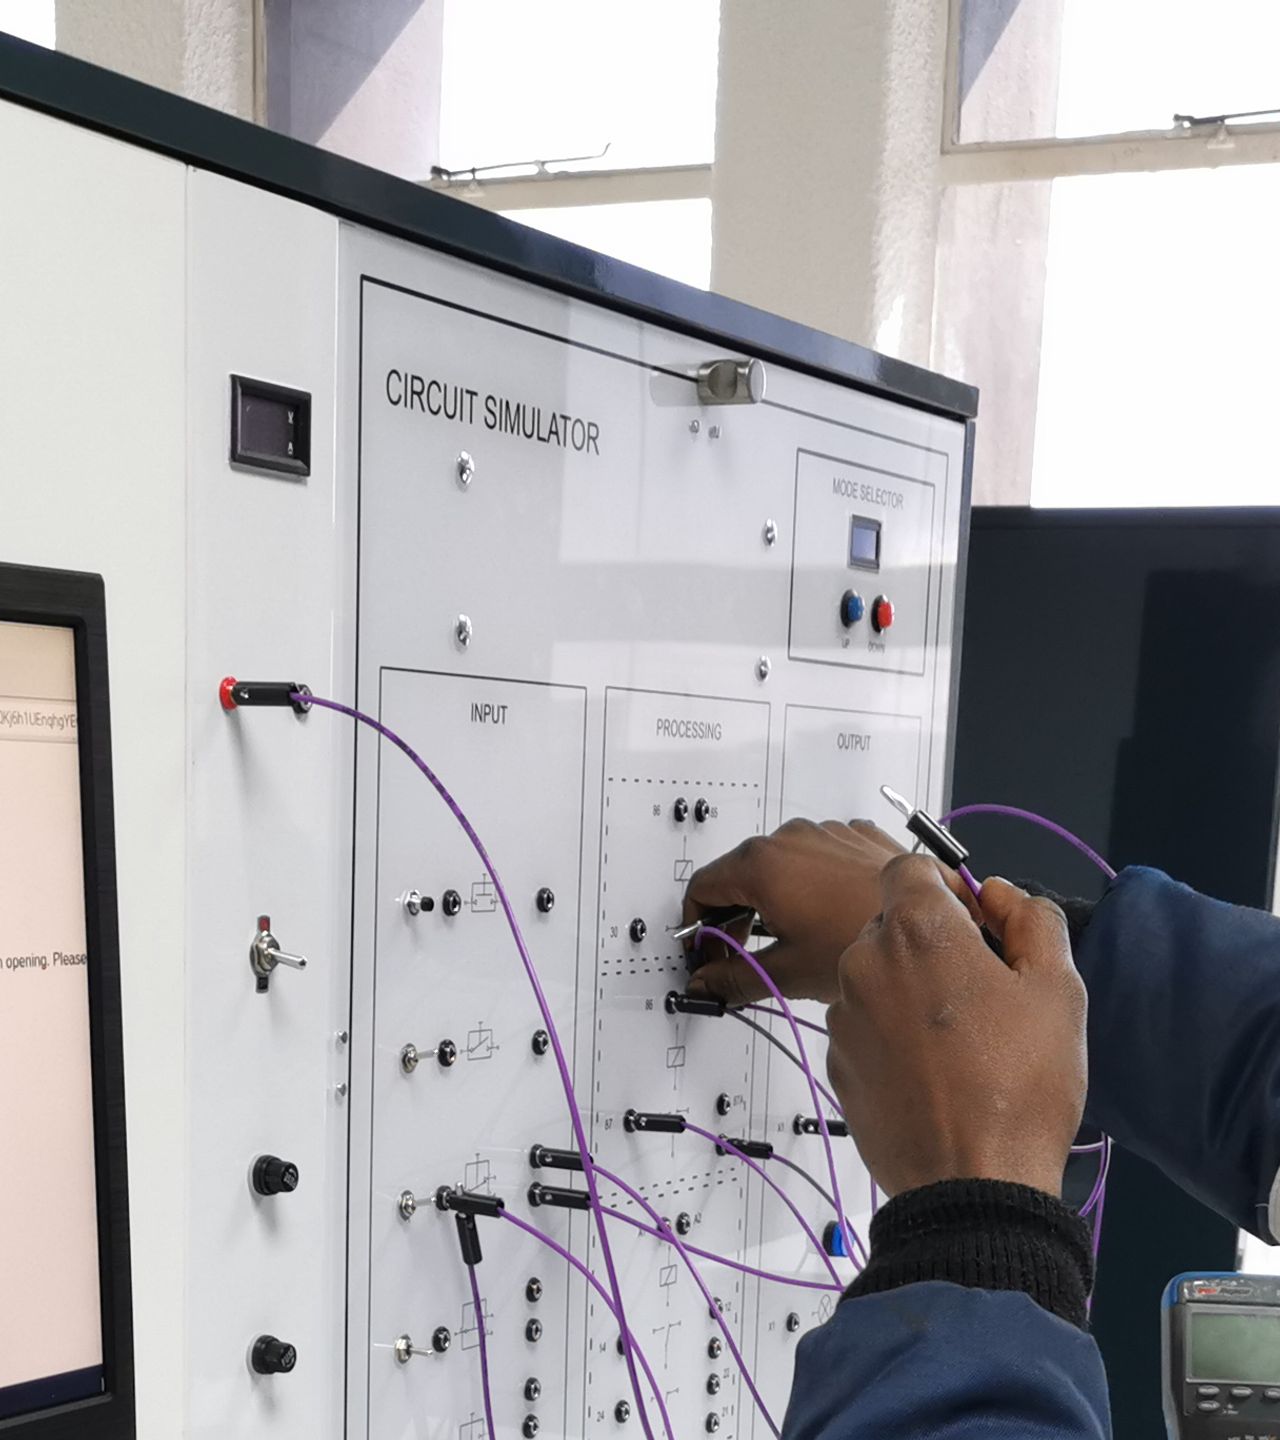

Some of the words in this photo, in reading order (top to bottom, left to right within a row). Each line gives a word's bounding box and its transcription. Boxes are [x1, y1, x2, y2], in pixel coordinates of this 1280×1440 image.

[385, 368, 478, 424] CIRCUIT
[483, 395, 600, 455] SIMULATOR
[832, 477, 859, 500] MODE
[859, 484, 904, 510] SELECTOR
[841, 638, 851, 649] UP
[470, 702, 508, 726] INPUT
[656, 718, 722, 741] PROCESSING
[836, 732, 871, 752] OUTPUT
[5, 952, 50, 972] opening.
[52, 951, 87, 967] Please
